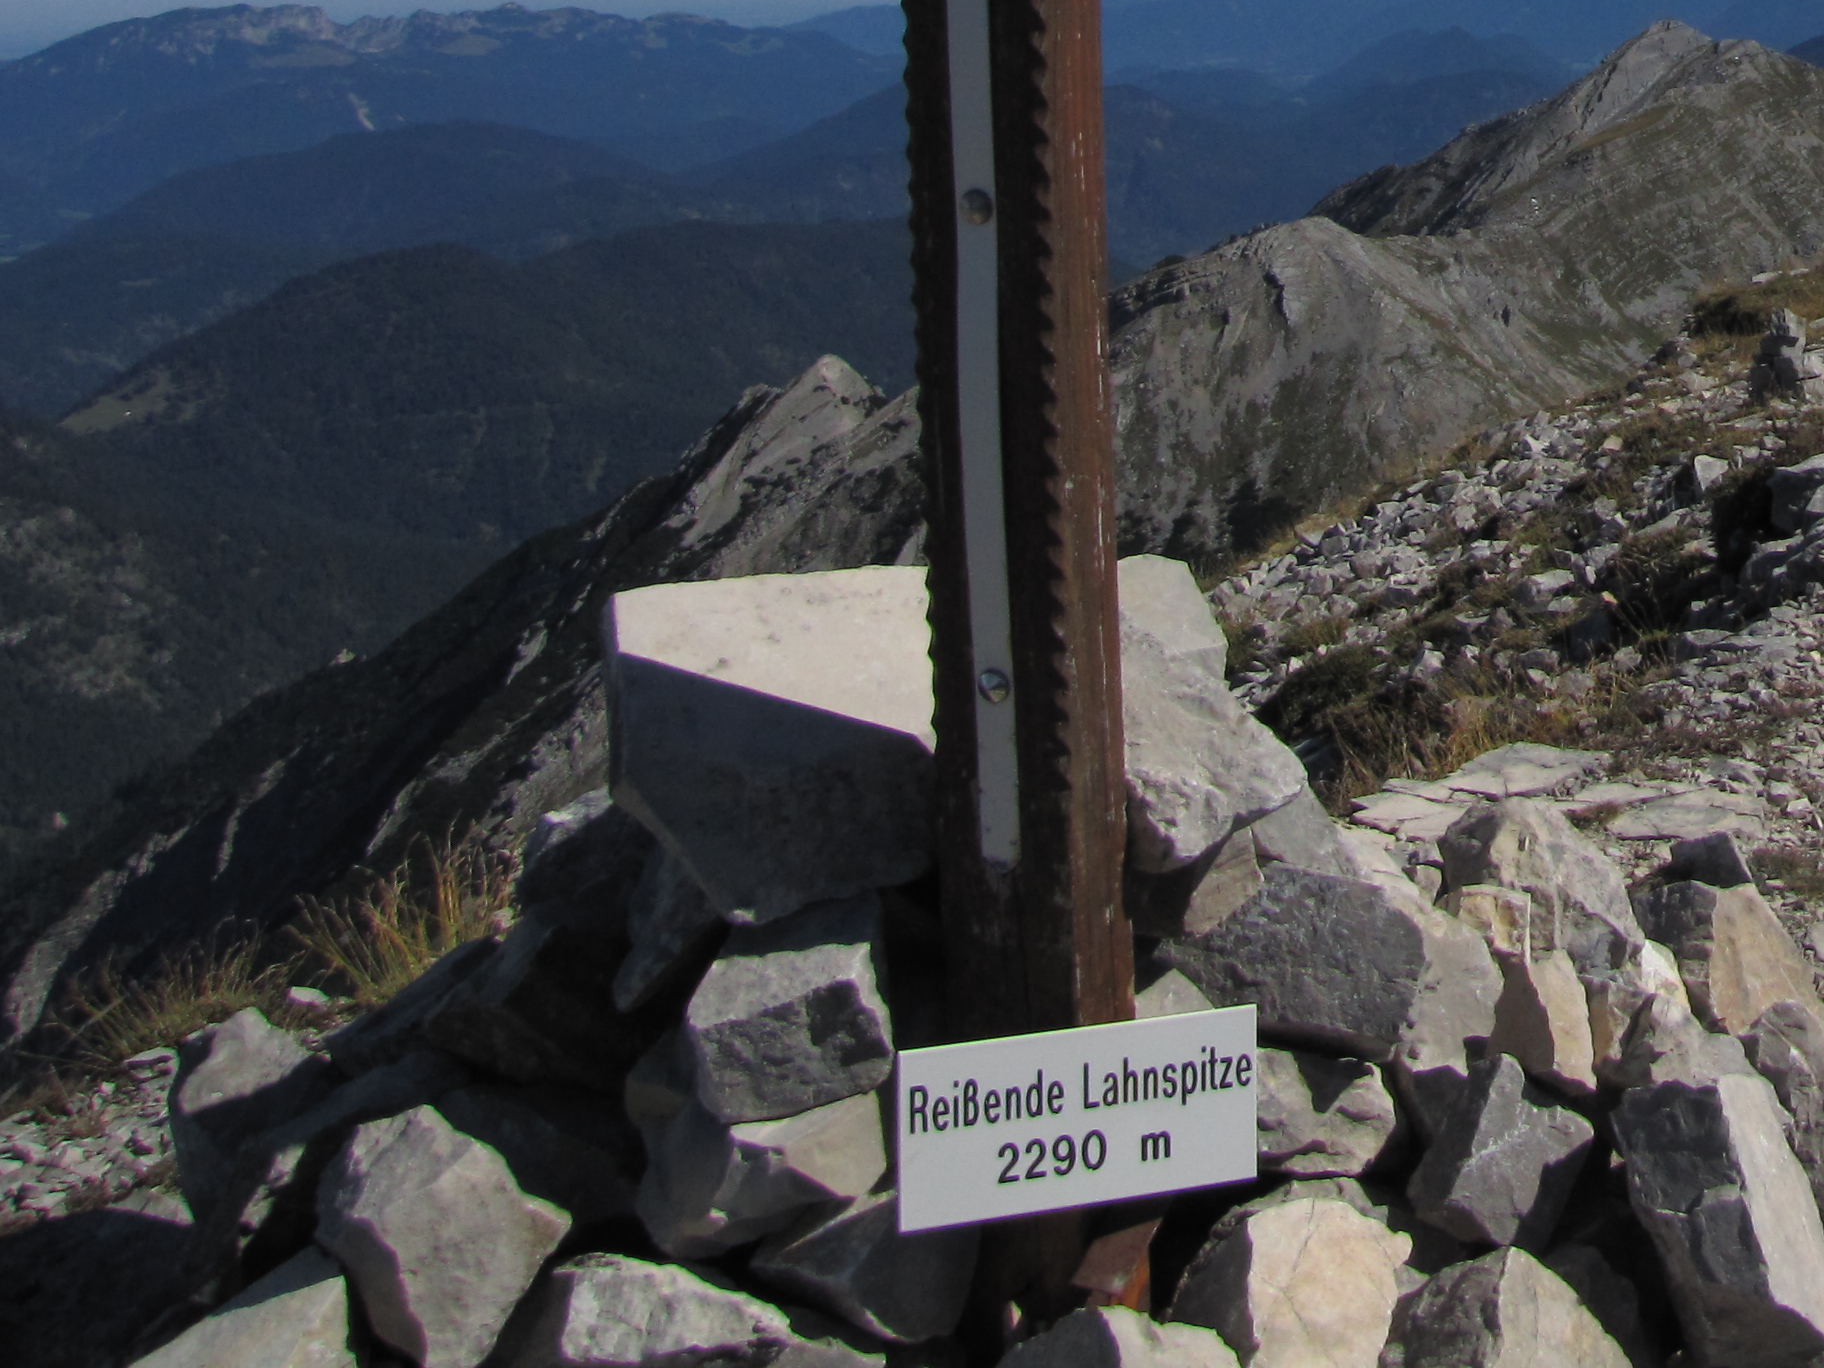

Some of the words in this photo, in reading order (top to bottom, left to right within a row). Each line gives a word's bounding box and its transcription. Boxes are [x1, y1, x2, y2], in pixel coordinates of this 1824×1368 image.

[909, 1069, 1065, 1135] Reißende
[1083, 1045, 1253, 1108] Lahnspitze
[997, 1129, 1107, 1185] 2290
[1140, 1130, 1171, 1162] m
